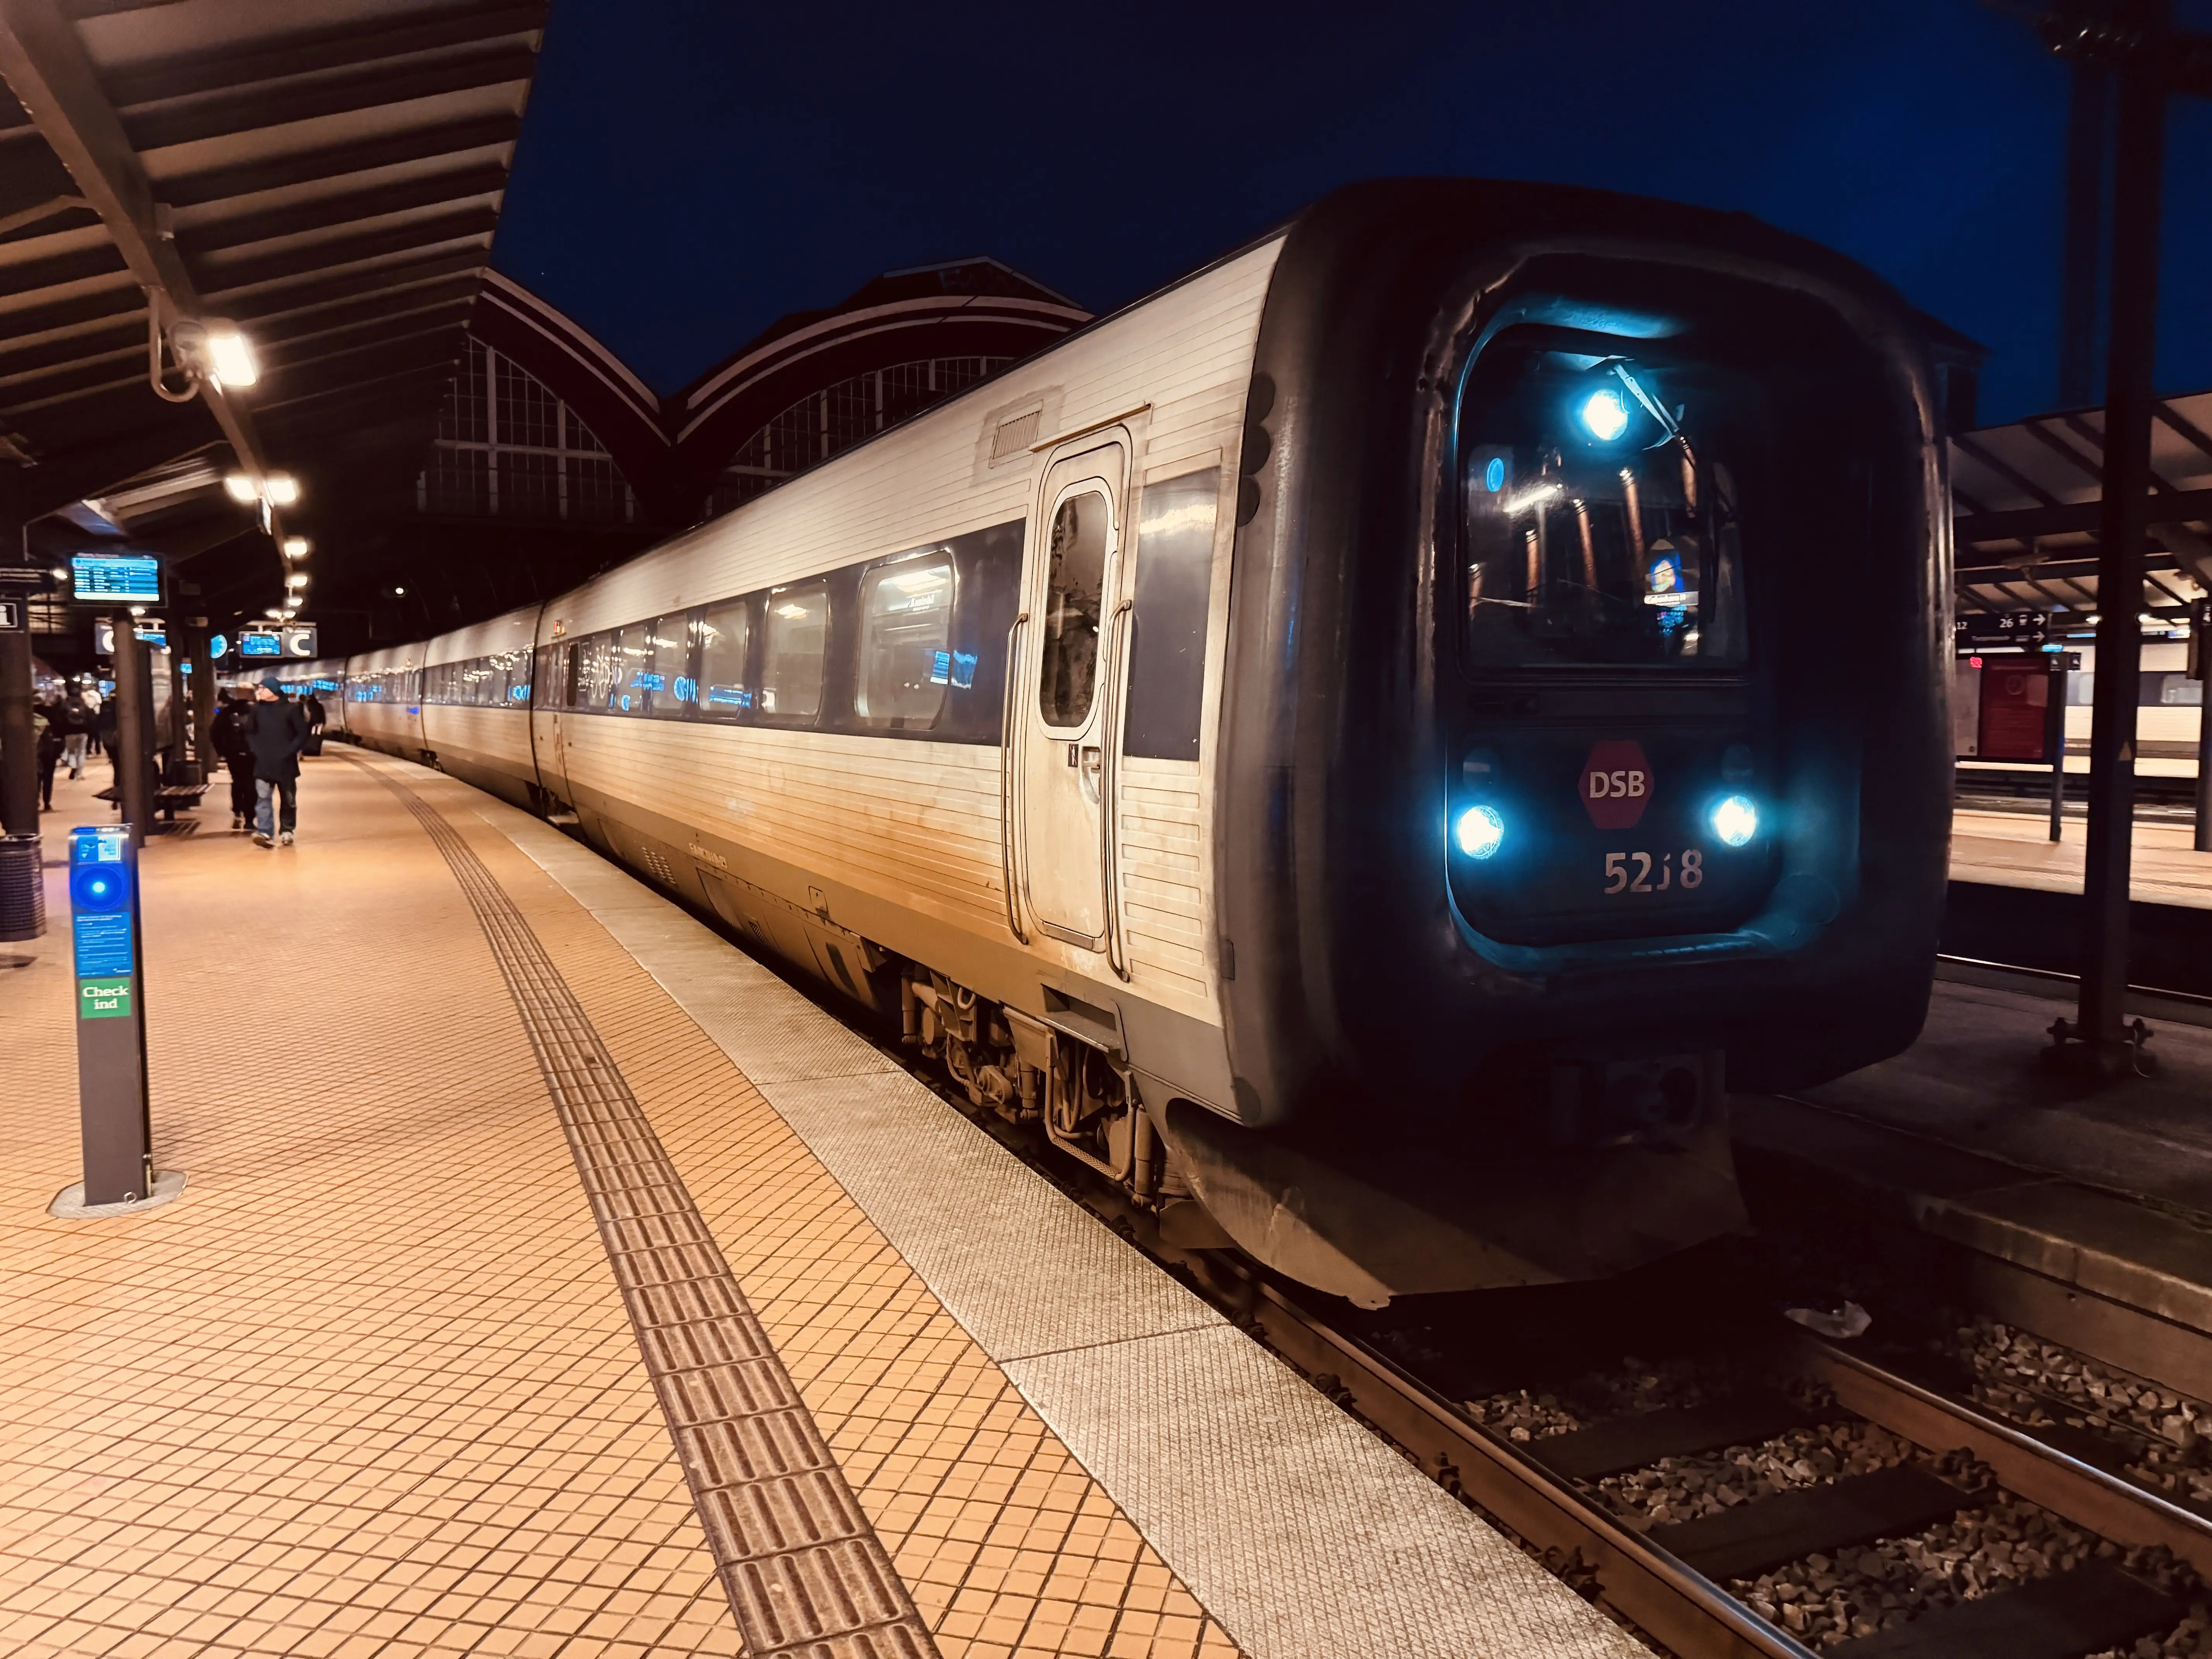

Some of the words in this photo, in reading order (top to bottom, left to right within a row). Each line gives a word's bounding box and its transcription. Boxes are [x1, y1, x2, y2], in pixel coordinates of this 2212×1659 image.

[1999, 618, 2014, 628] 26
[290, 634, 310, 656] C
[1590, 771, 1645, 798] DSB
[82, 985, 129, 997] Check
[94, 998, 118, 1010] ind
